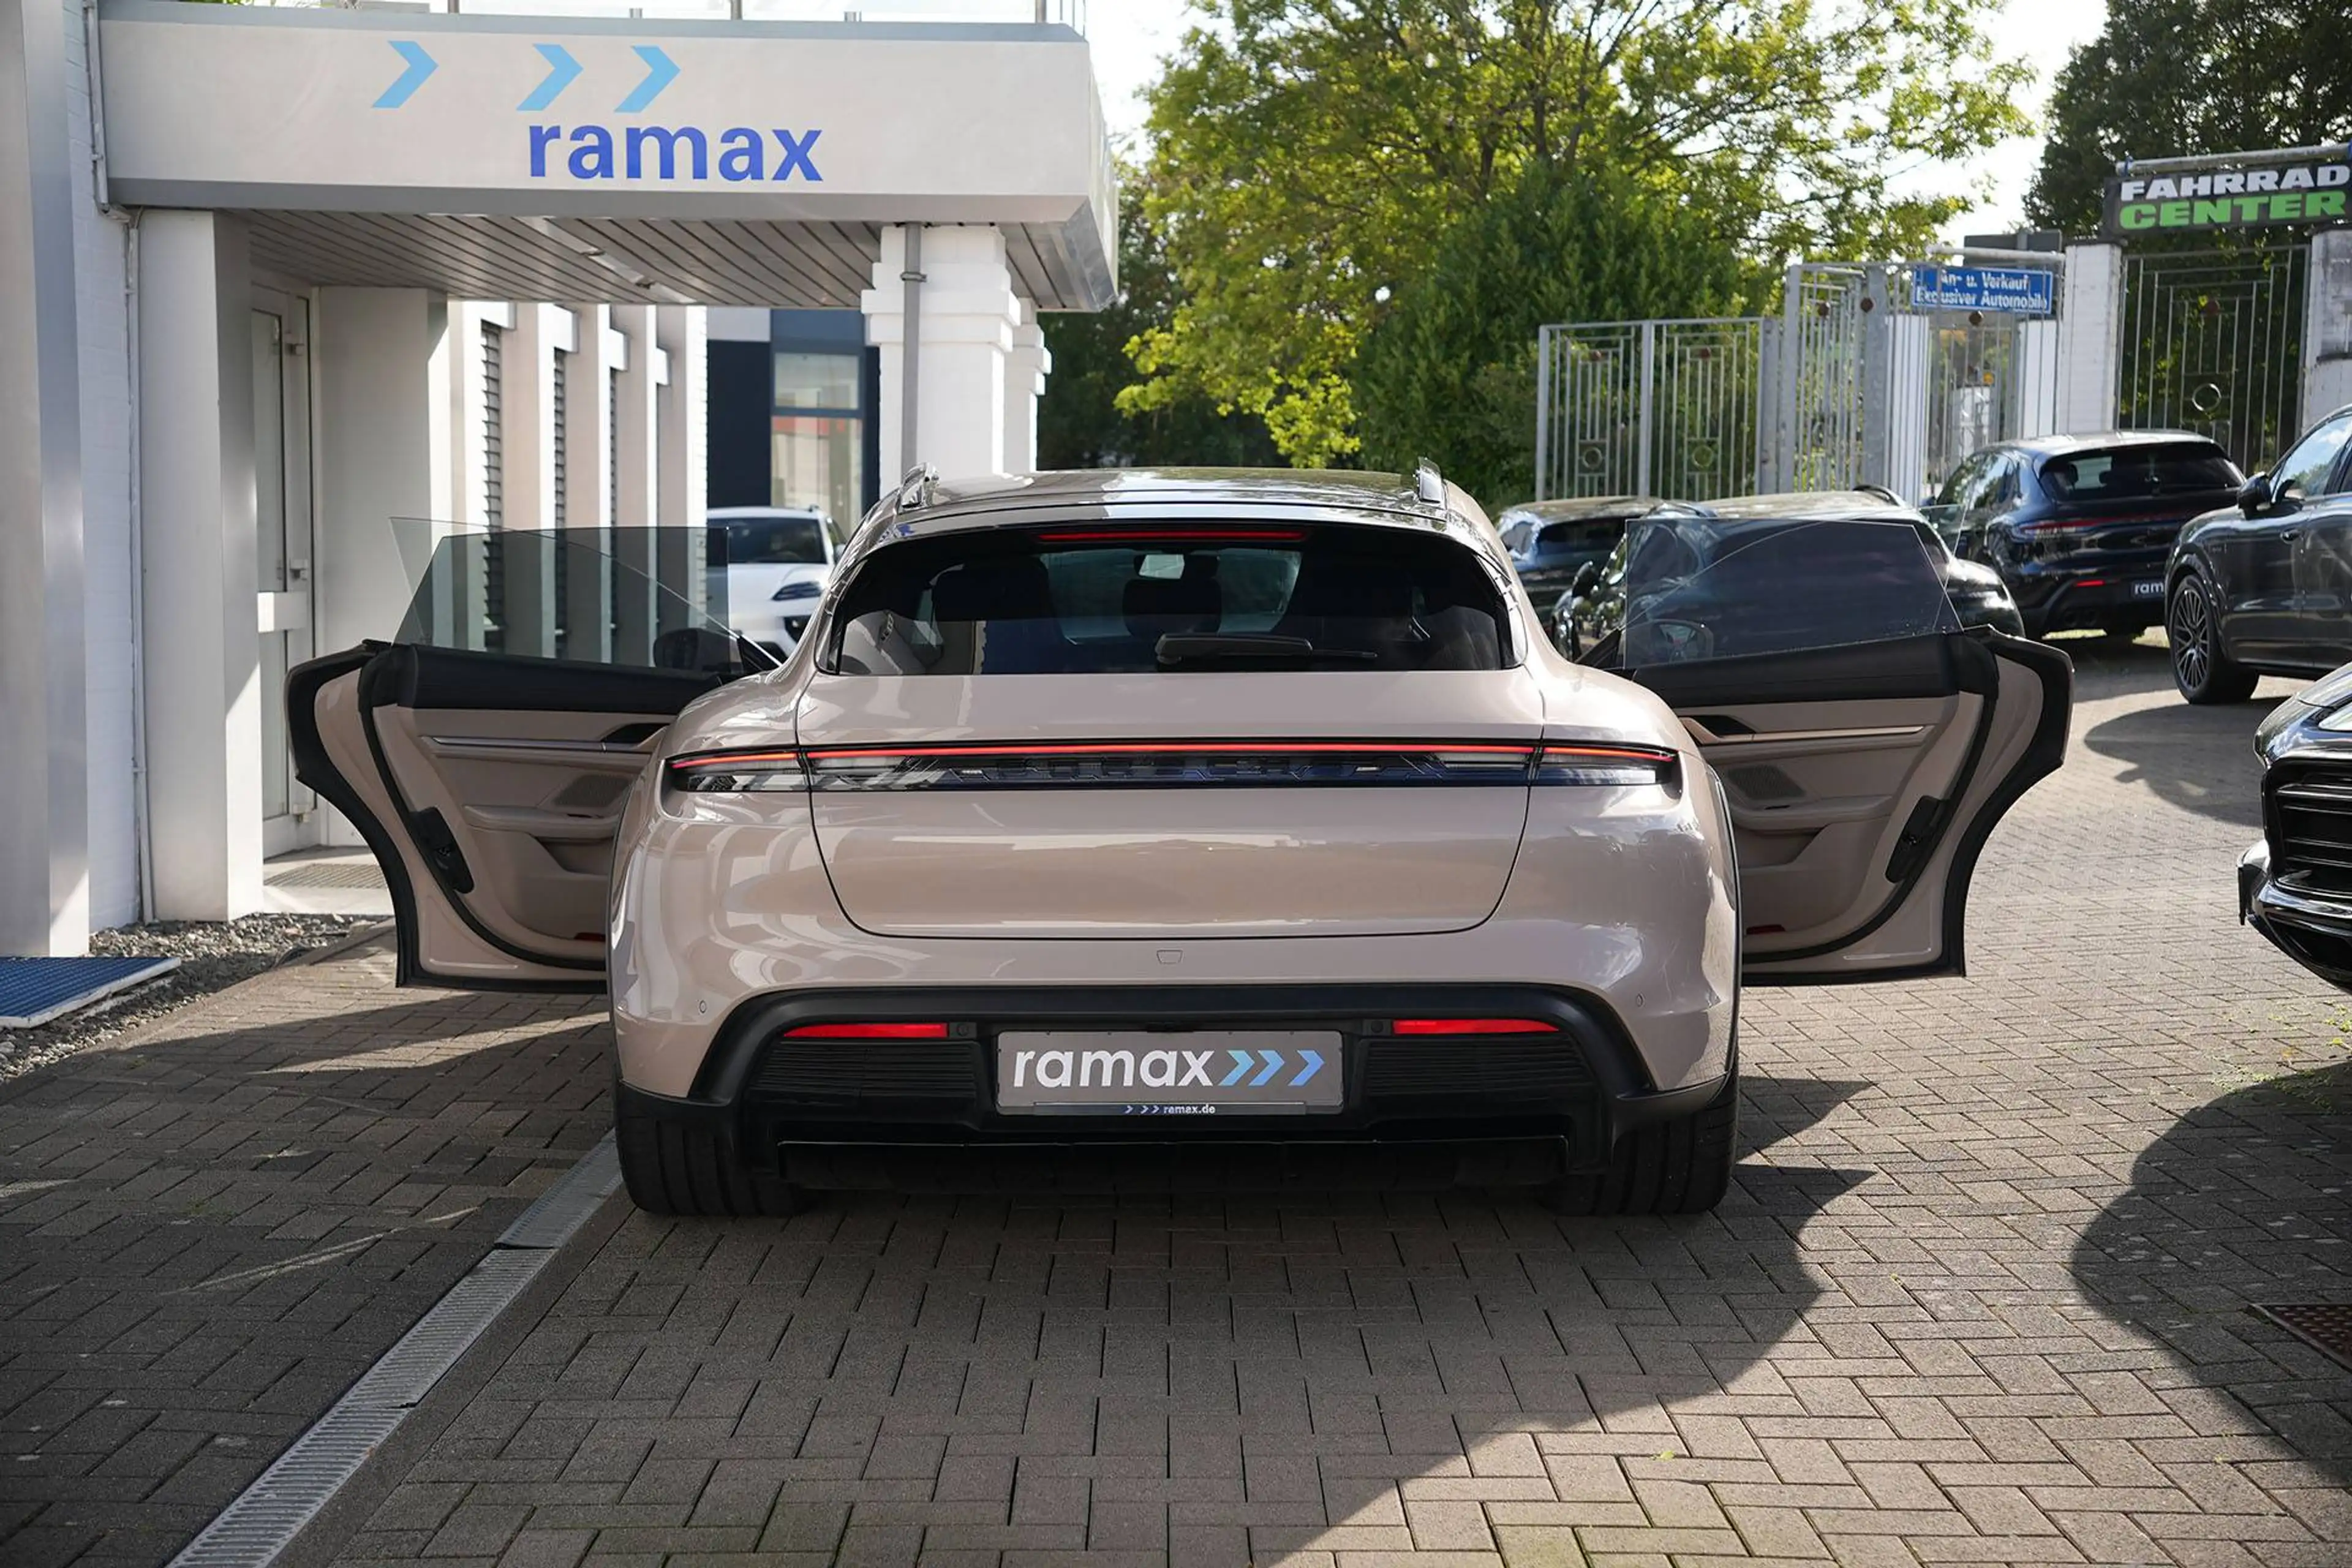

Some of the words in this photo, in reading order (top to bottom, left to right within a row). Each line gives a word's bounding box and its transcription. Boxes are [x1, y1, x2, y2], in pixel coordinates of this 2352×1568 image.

[529, 124, 823, 181] ramax
[2121, 165, 2350, 202] FAHRRAD
[2119, 190, 2346, 230] CENTER
[1982, 272, 2029, 290] Verkauf
[1916, 287, 1977, 305] Excusiver
[1981, 290, 2048, 310] Automobile
[2135, 582, 2164, 594] ram
[1013, 1050, 1215, 1087] ramax
[1163, 1102, 1216, 1114] ramax.de
